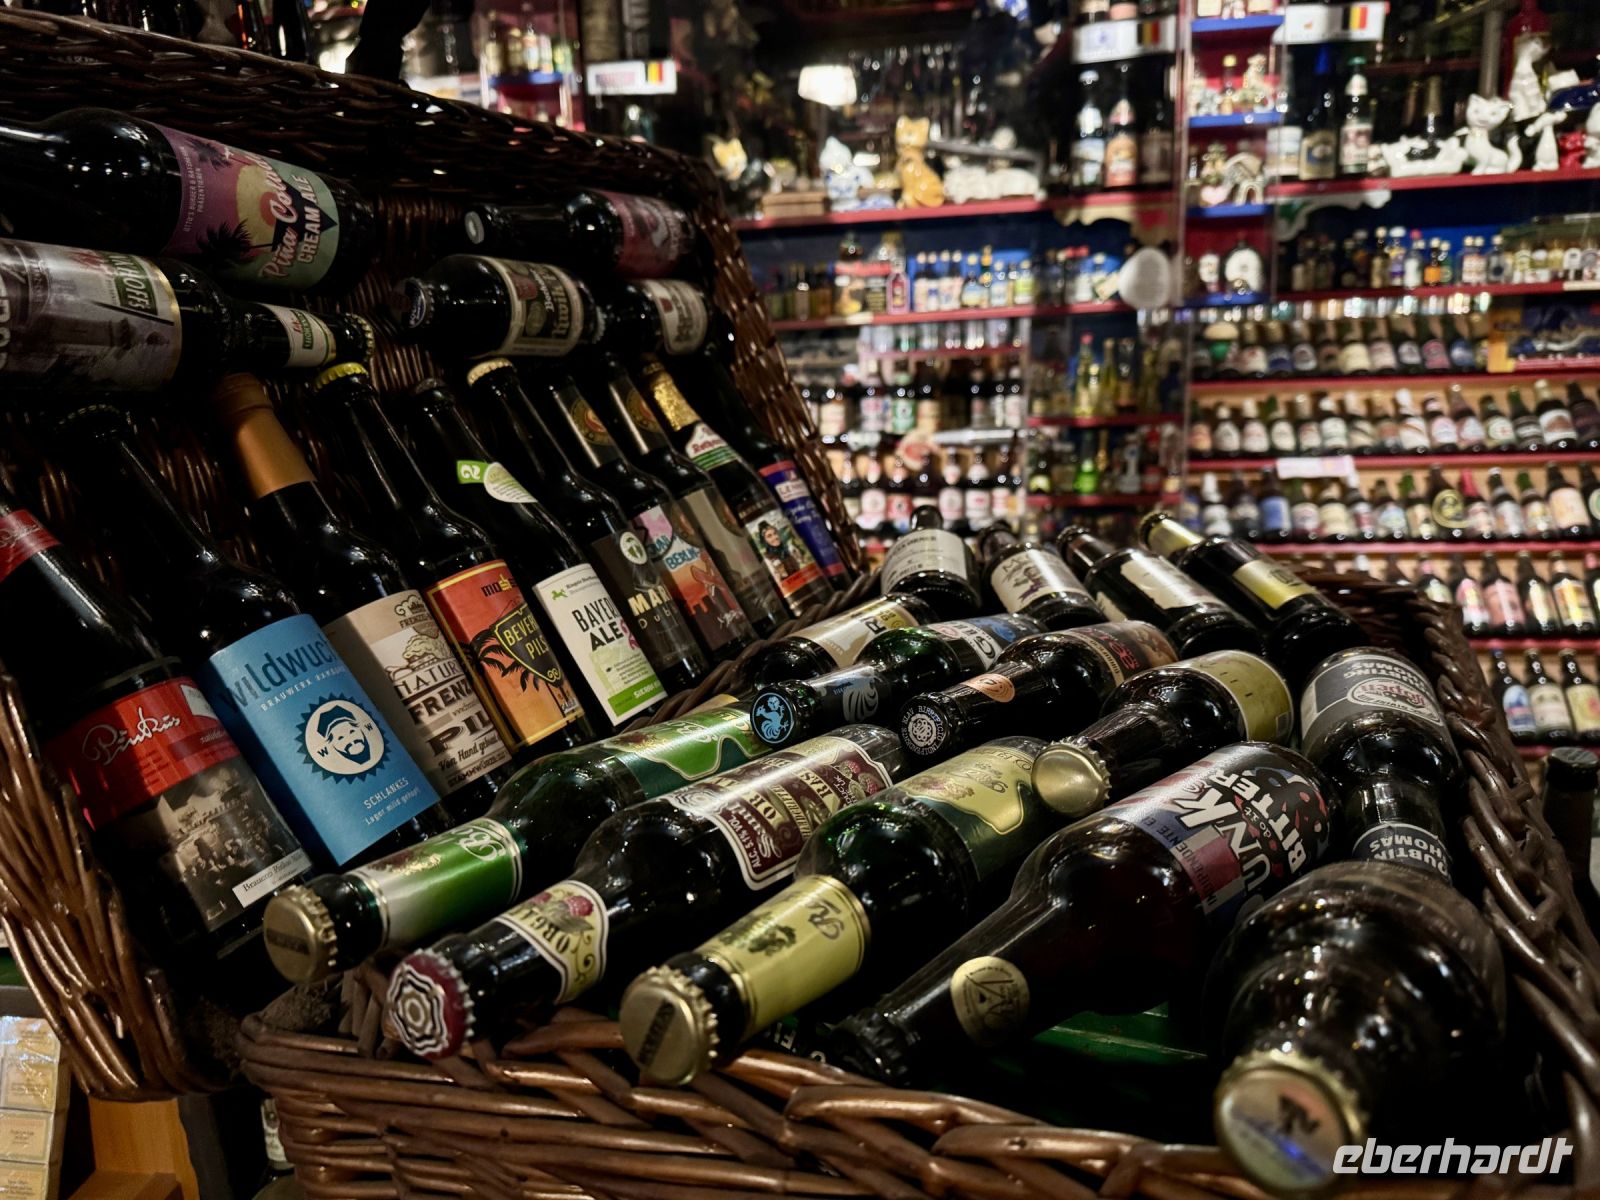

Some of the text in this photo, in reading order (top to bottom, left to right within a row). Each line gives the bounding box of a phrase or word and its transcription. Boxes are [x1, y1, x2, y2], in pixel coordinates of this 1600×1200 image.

[291, 174, 322, 263] CREAM ALE
[259, 227, 299, 278] Piña
[587, 621, 625, 652] ALE
[429, 711, 493, 757] PIL
[438, 753, 459, 772] Von
[457, 743, 479, 762] Hand
[363, 777, 410, 810] SCHLANKES
[1175, 789, 1273, 893] UNK
[1207, 766, 1307, 875] BITTER
[1243, 805, 1273, 843] do it
